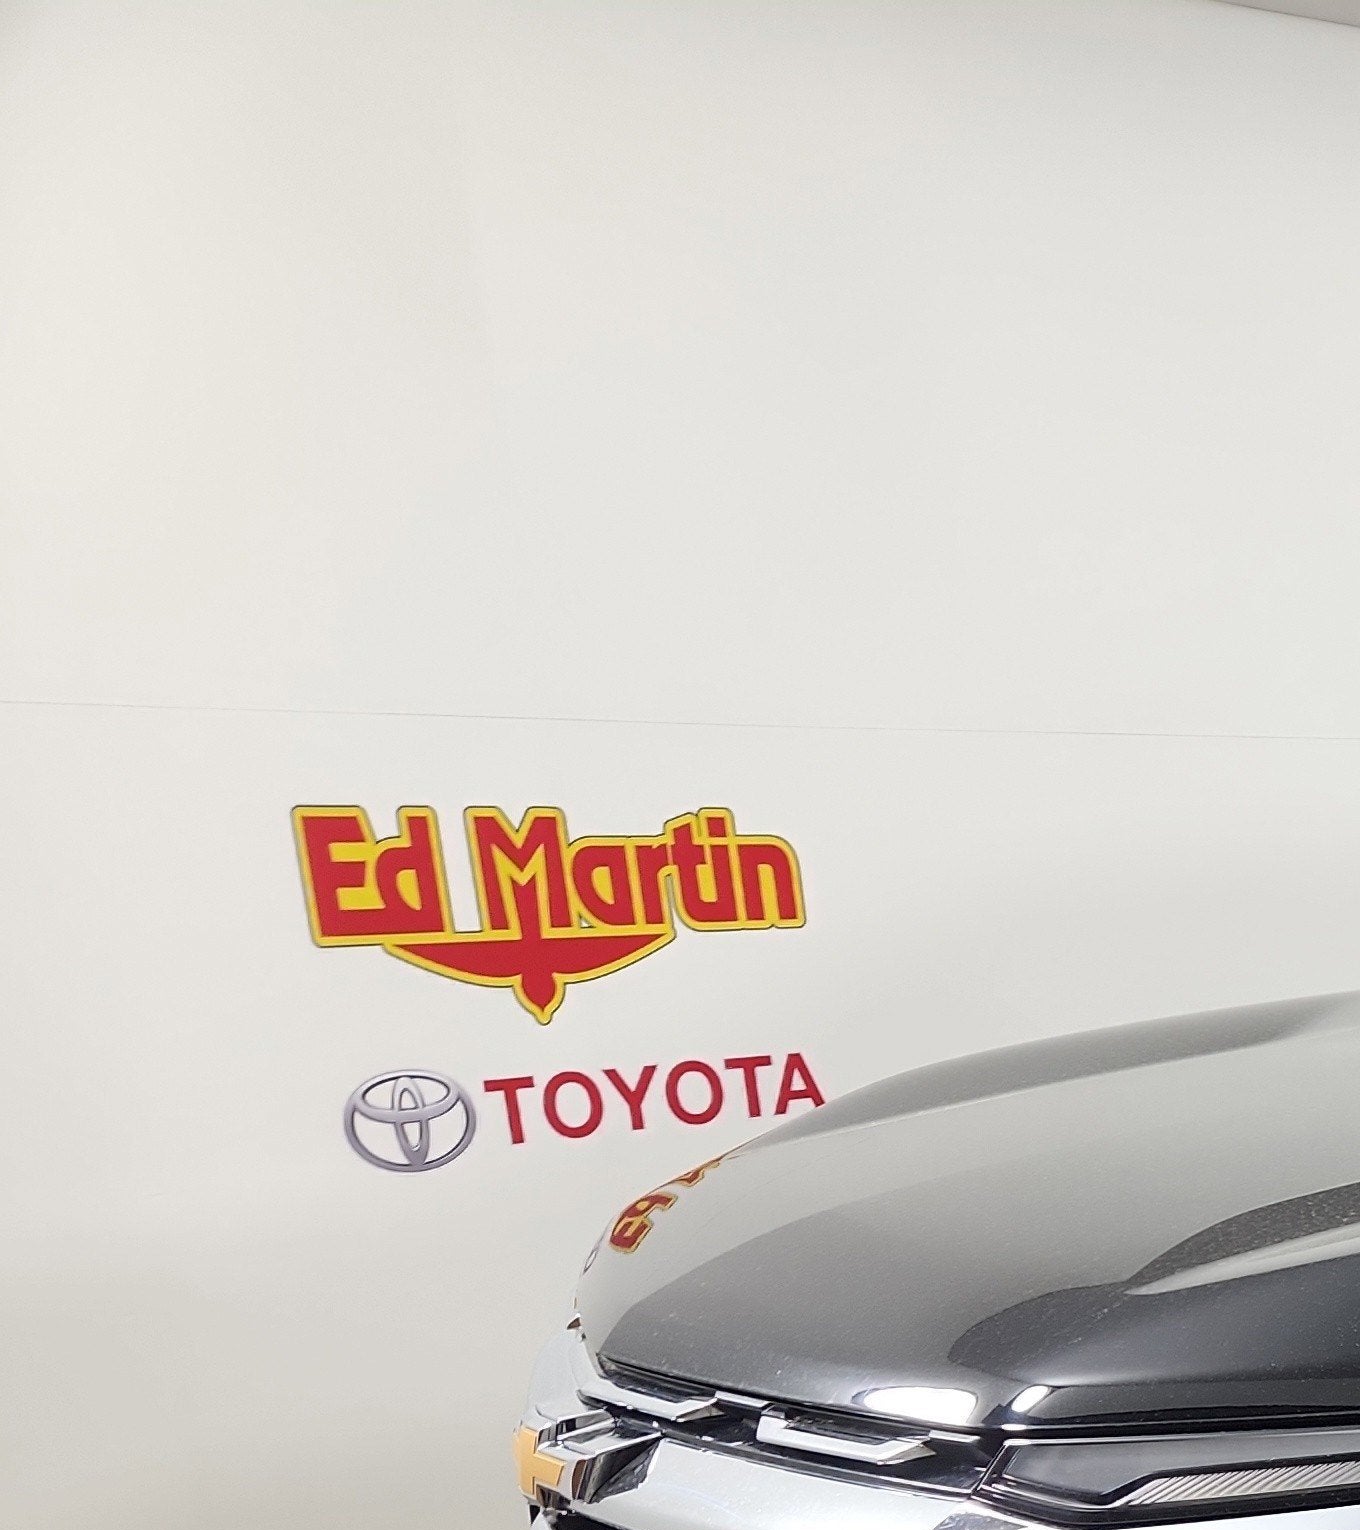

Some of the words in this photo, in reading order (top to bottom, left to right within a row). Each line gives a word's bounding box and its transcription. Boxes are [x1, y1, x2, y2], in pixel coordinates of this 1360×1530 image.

[300, 814, 446, 937] Ed
[472, 814, 799, 931] Martin
[483, 1052, 826, 1145] TOYOTA
